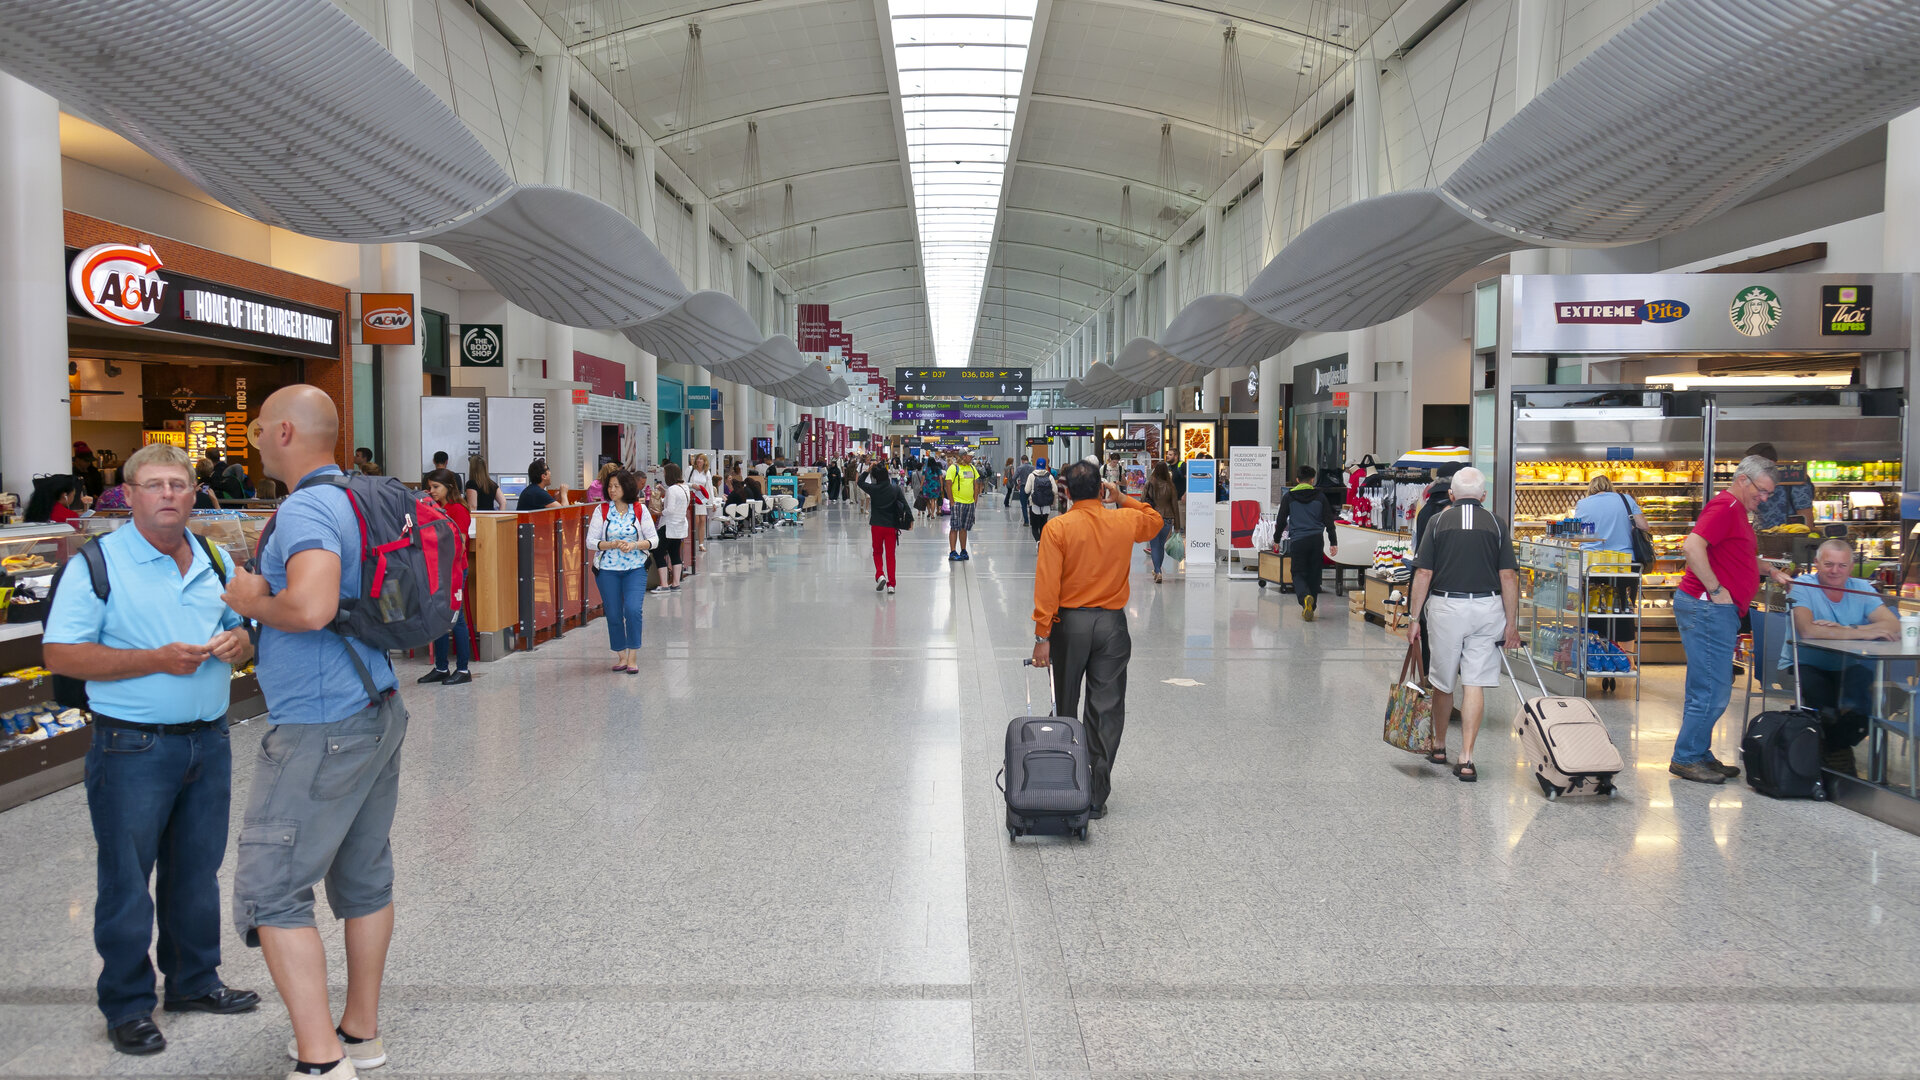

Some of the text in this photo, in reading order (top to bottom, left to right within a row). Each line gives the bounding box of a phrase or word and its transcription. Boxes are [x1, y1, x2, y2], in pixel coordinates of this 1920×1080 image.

[97, 270, 168, 314] A&W
[196, 290, 333, 345] HOME OF THE BURGER FAMILY
[372, 316, 408, 326] A&W
[1560, 305, 1636, 318] EXTREME
[1646, 303, 1683, 320] Pita
[1831, 322, 1865, 332] express
[236, 378, 247, 410] ICE COLD
[468, 402, 480, 433] ORDER
[533, 403, 545, 433] ORDER
[226, 412, 248, 458] ROOT
